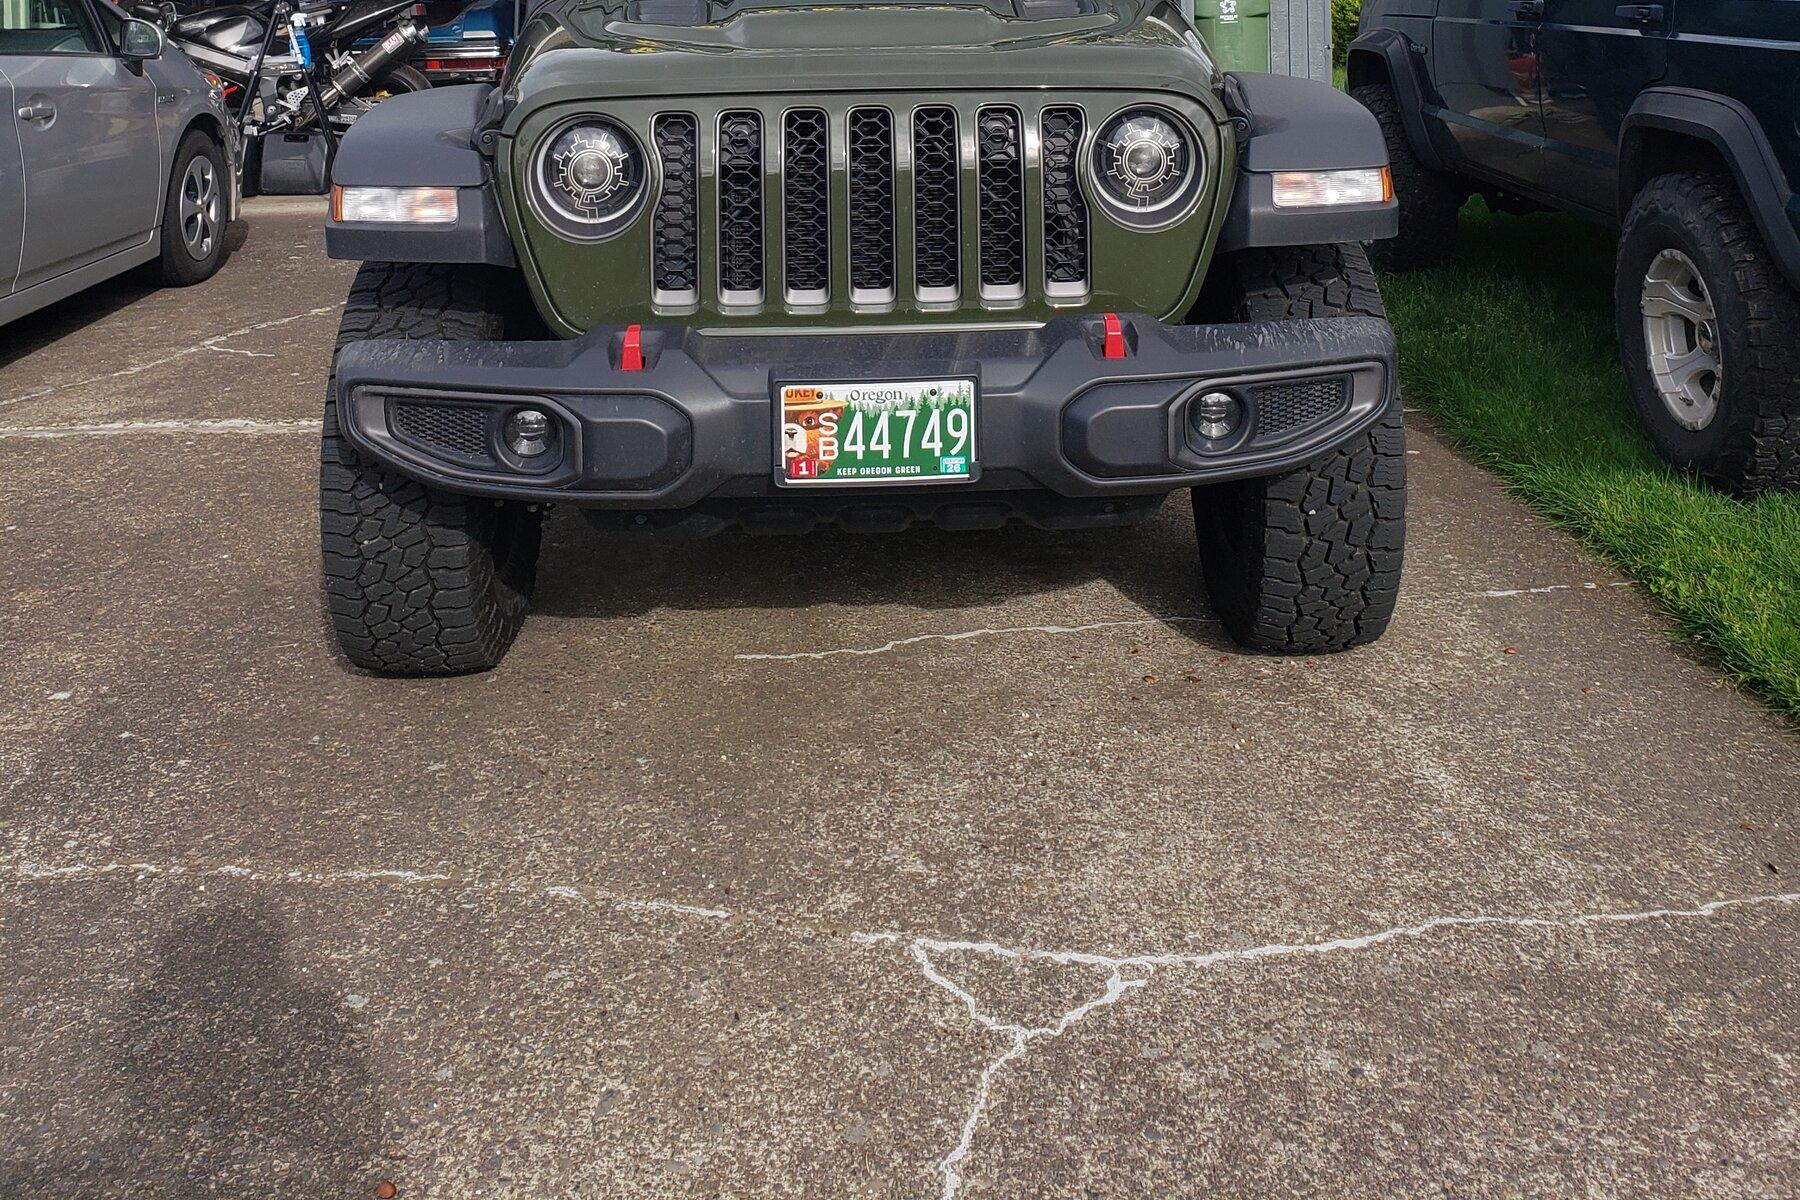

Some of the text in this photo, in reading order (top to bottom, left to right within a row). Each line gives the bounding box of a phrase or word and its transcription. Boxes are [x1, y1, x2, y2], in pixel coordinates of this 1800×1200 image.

[850, 389, 903, 404] Oregon
[843, 407, 968, 460] 44749
[836, 465, 921, 476] KEEP OREGON GREEN
[946, 463, 961, 473] 26
